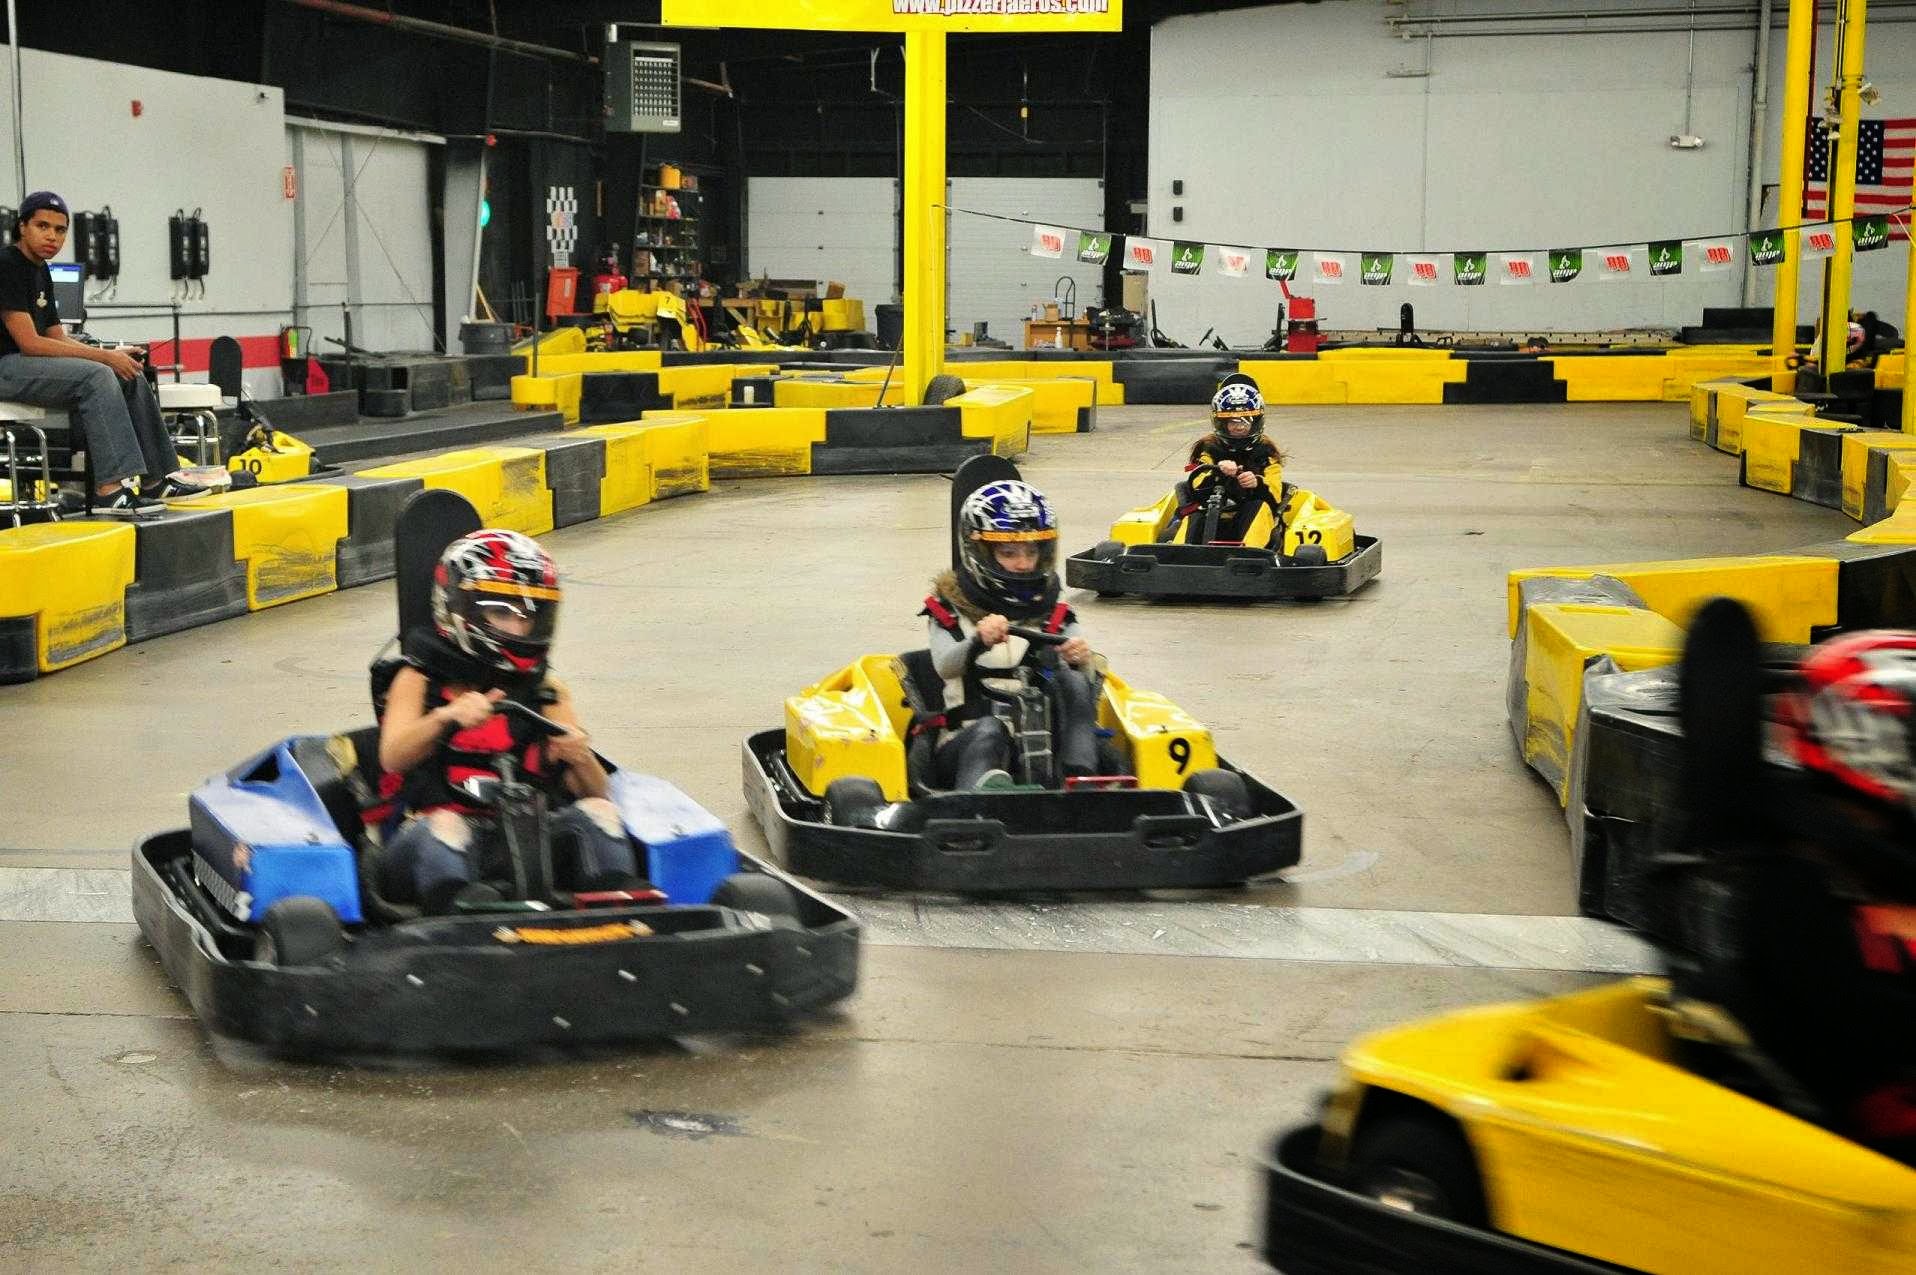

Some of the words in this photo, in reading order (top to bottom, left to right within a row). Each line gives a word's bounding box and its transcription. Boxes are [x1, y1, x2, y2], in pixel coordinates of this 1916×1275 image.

[239, 459, 262, 475] 10
[1295, 530, 1322, 545] 12
[1168, 737, 1191, 776] 9
